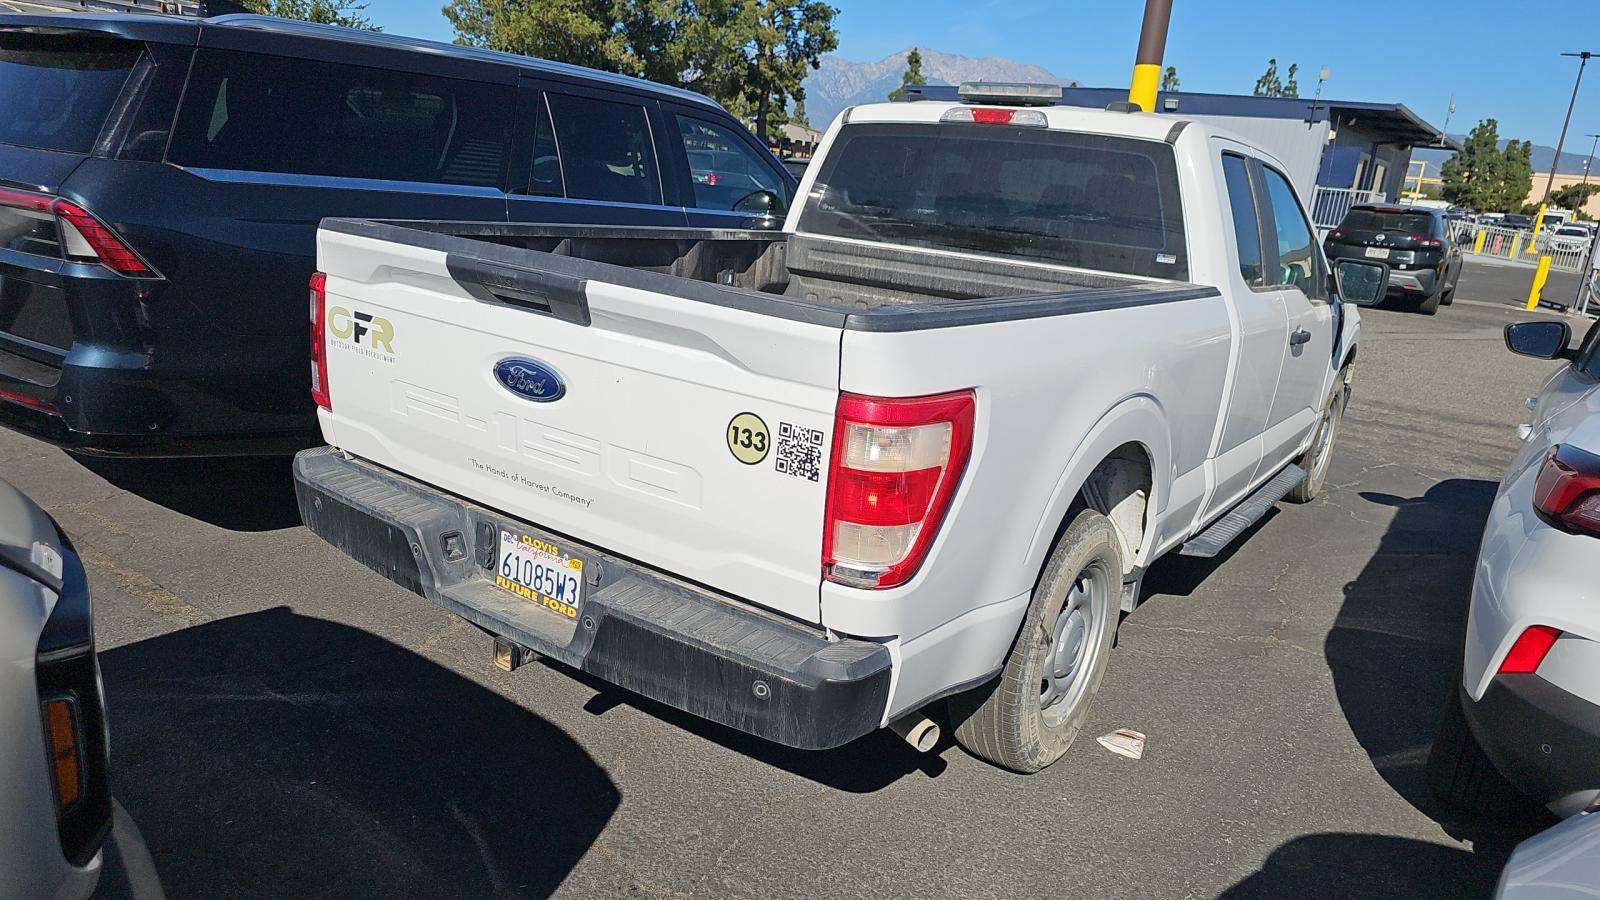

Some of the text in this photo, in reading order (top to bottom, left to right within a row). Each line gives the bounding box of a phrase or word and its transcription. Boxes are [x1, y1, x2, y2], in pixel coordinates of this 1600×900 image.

[328, 306, 394, 353] OFR
[508, 365, 546, 395] Ford
[732, 425, 766, 452] 133
[486, 465, 509, 479] Hands
[511, 473, 519, 482] of
[521, 475, 550, 493] Harvest
[522, 535, 559, 555] CLOVIS
[502, 552, 578, 605] 61085W3
[496, 575, 577, 618] FUTURE FORD
